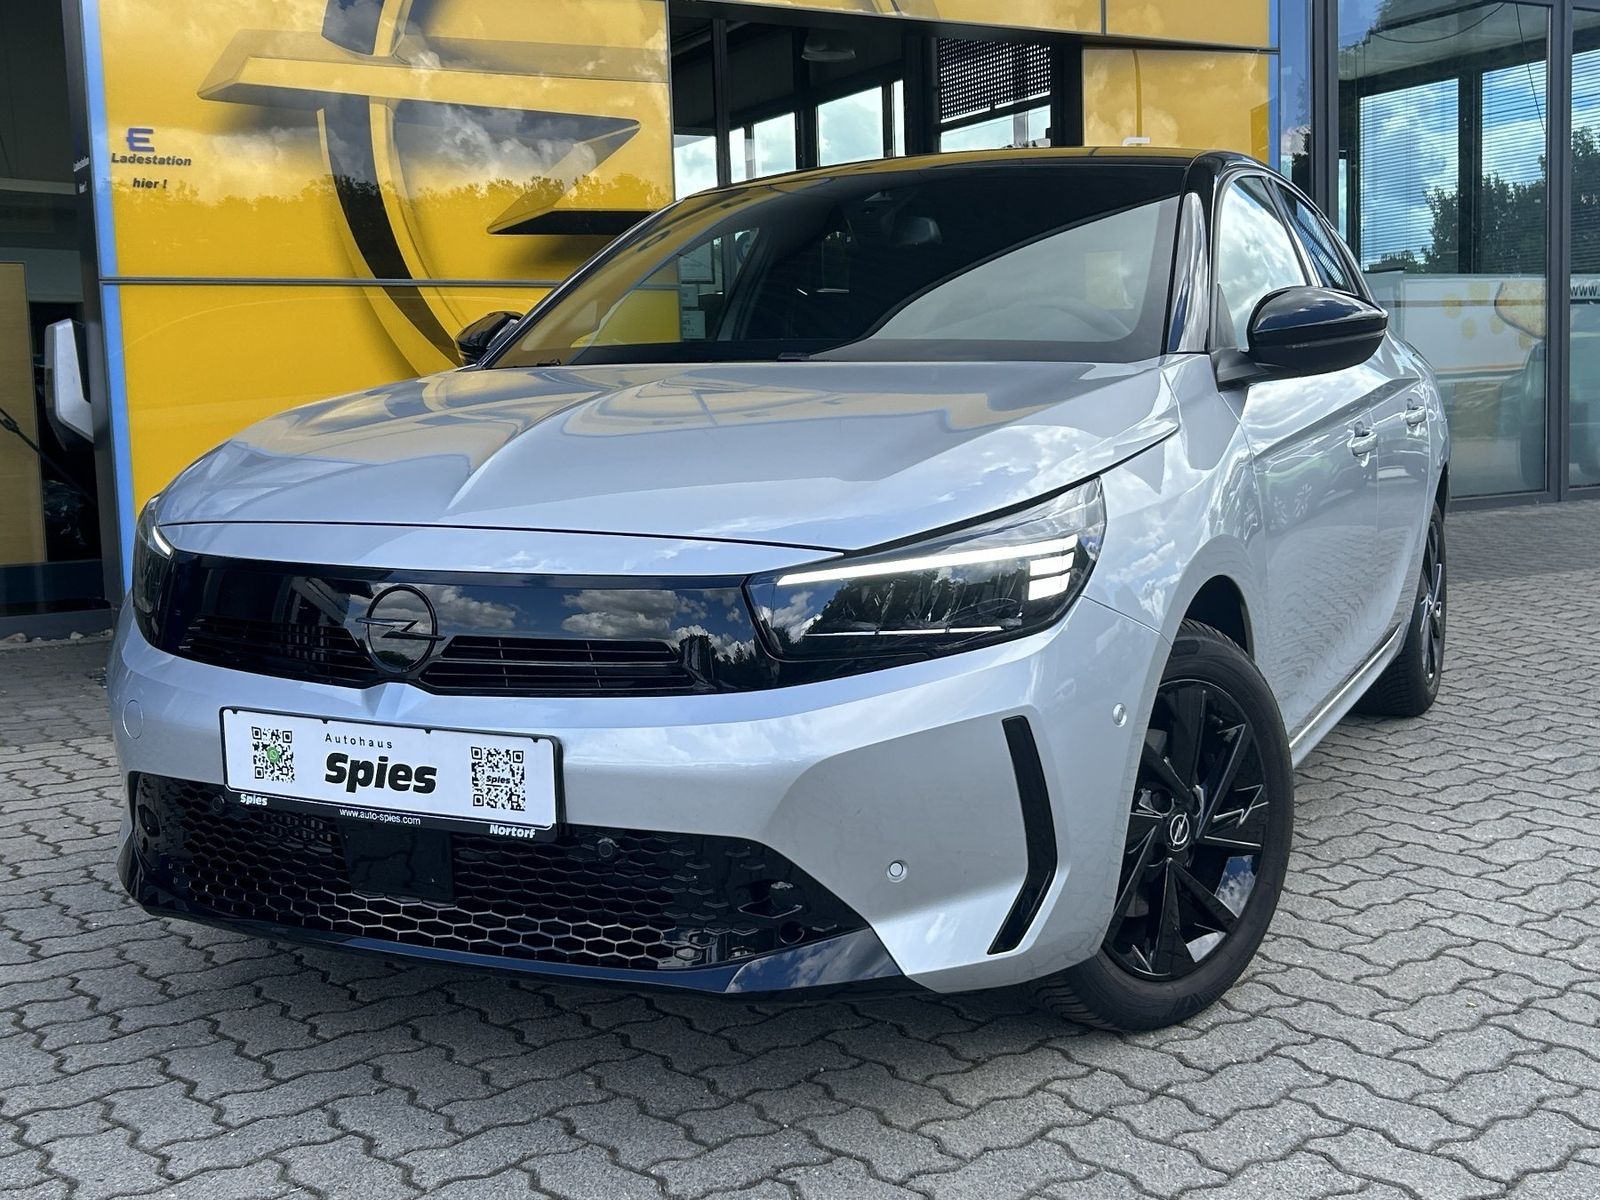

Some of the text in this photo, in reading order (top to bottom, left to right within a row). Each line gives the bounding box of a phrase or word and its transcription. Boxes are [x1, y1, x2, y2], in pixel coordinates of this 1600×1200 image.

[111, 152, 192, 166] Ladestation
[132, 178, 160, 189] hier
[324, 733, 393, 749] Autohaus
[324, 752, 437, 794] Spies
[486, 775, 511, 784] Spies
[240, 793, 268, 806] Spies
[339, 808, 421, 826] www.auto-spies.com
[489, 824, 536, 839] Nortorf
